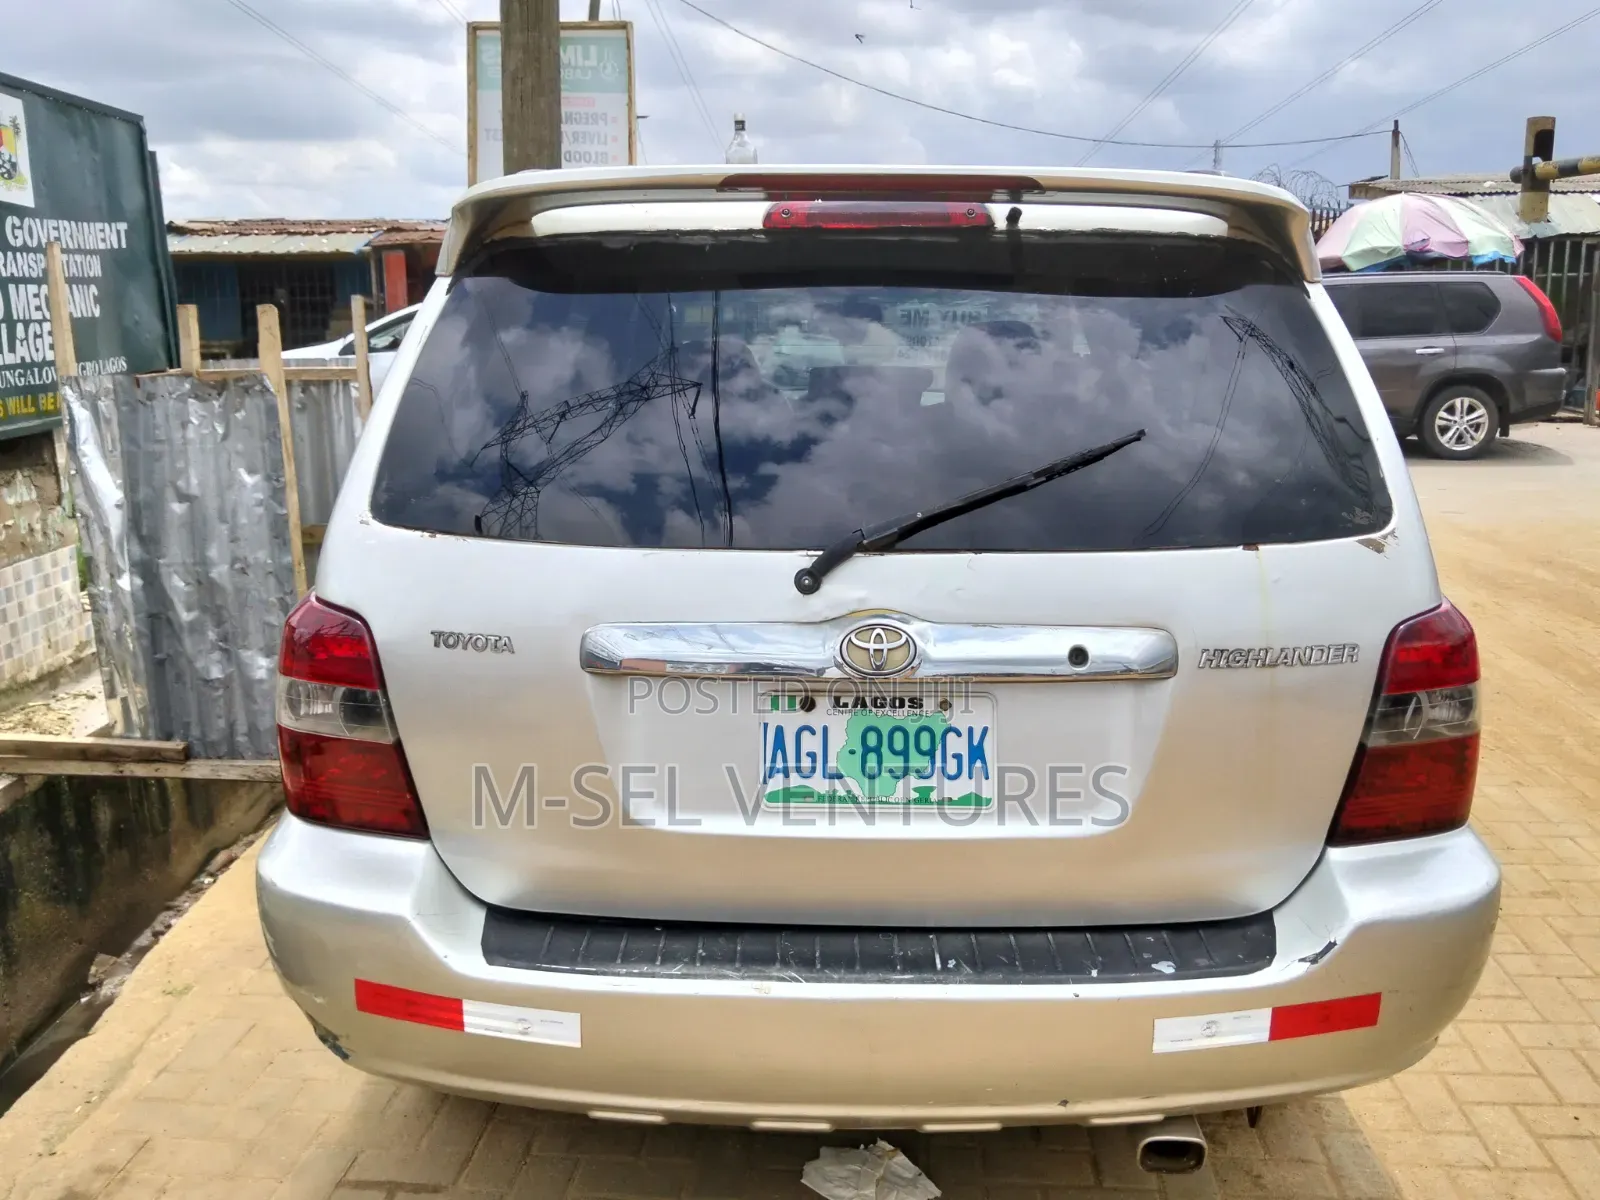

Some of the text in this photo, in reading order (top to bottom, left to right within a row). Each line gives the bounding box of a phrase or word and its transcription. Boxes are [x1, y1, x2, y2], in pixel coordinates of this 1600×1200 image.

[5, 215, 128, 250] GOVERNMENT
[8, 283, 101, 320] MECANIC
[99, 356, 128, 375] LAGOS
[5, 394, 36, 416] WILL
[430, 629, 515, 654] TOYOTA
[1198, 643, 1360, 669] HIGHLANDER
[832, 695, 924, 710] LAGOS
